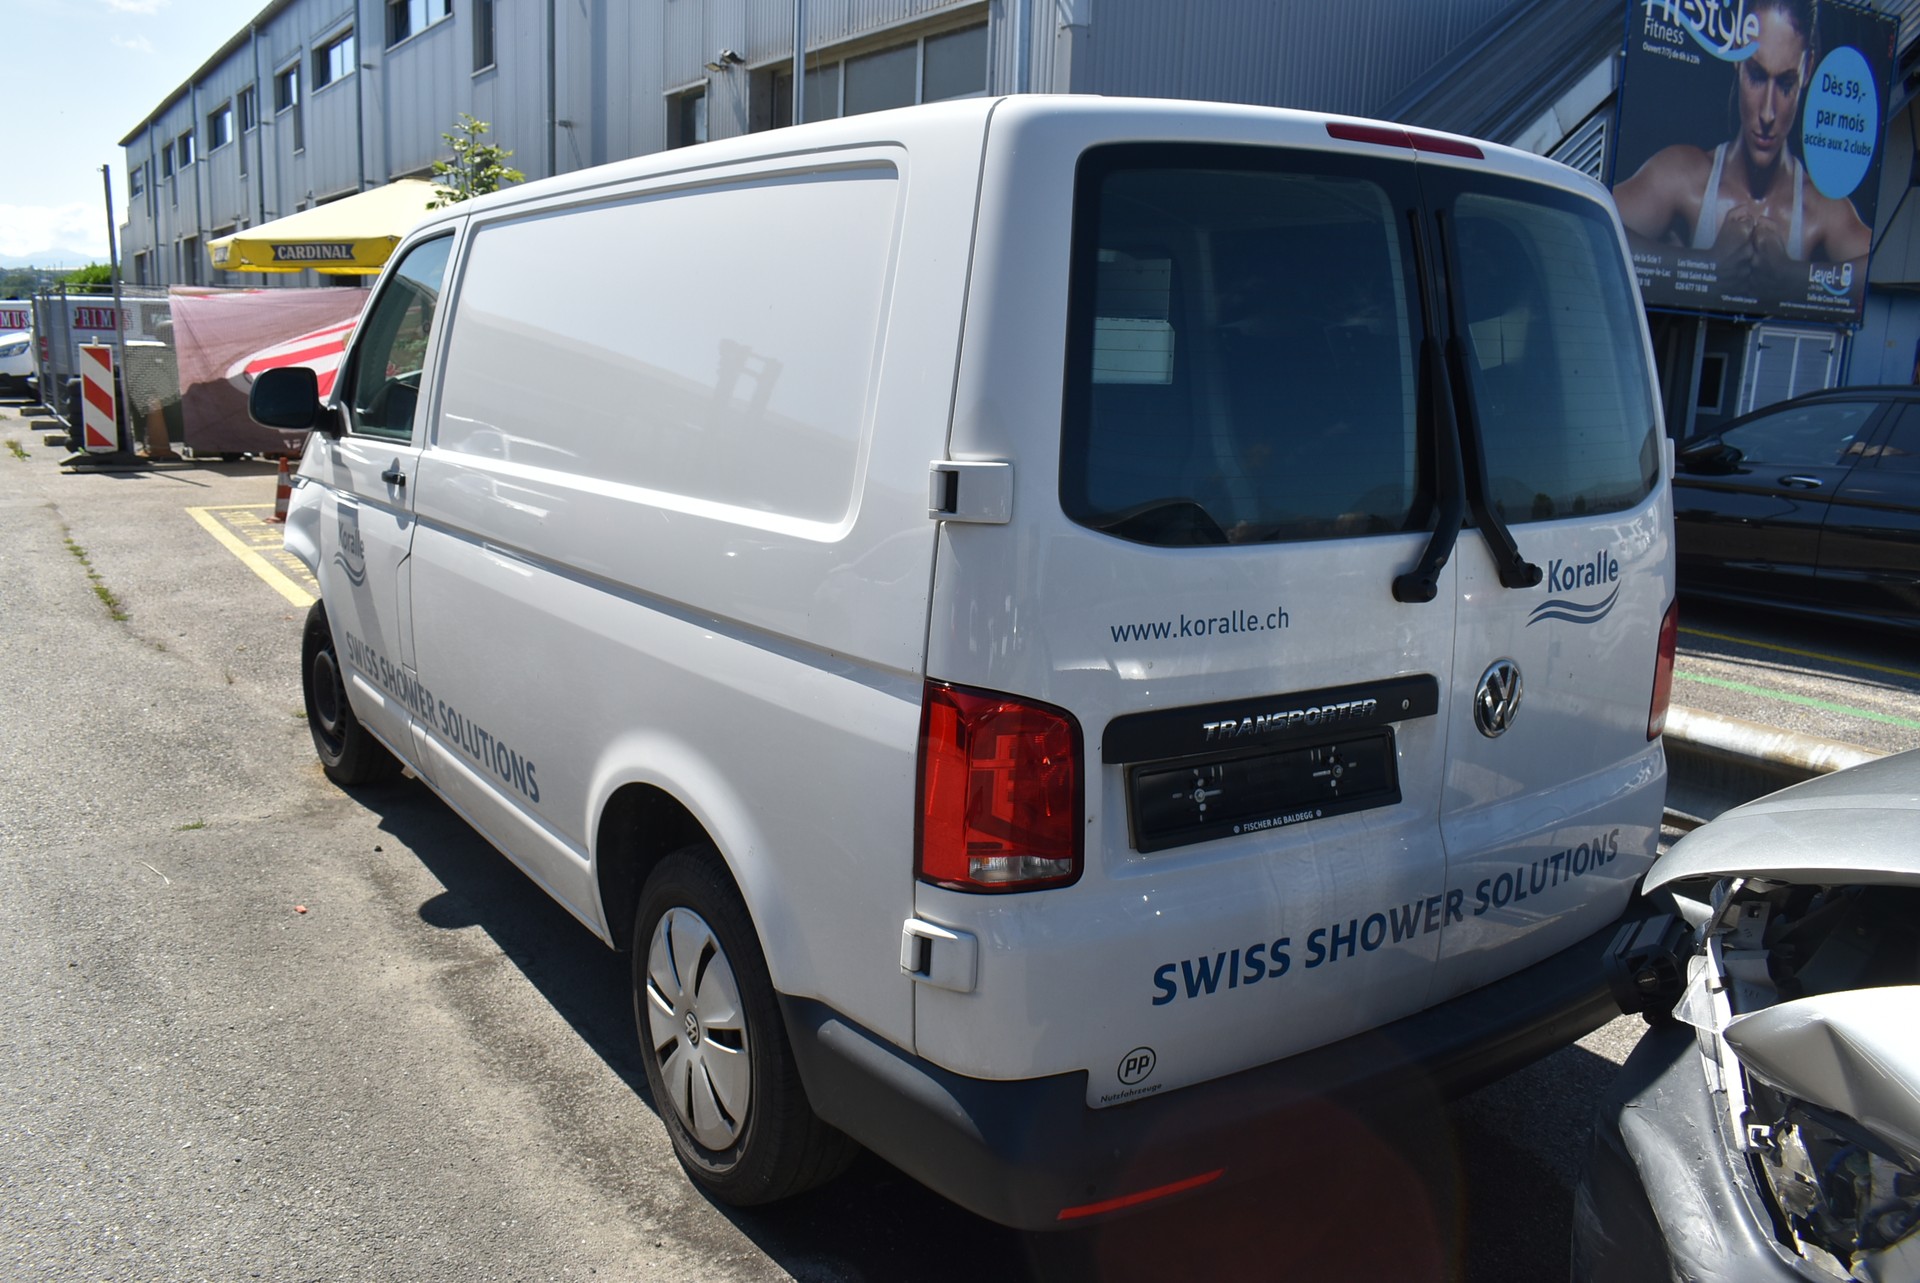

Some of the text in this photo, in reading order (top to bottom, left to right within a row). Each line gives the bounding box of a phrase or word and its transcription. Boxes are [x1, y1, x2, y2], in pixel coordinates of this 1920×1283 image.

[1644, 17, 1684, 45] Fitness
[1822, 73, 1843, 96] Dès
[1816, 110, 1865, 133] par mois
[1804, 133, 1871, 157] accès aux 2 clubs
[277, 245, 350, 260] CARDINAL
[1547, 550, 1620, 593] Koralle
[1110, 606, 1290, 643] www.koralle.ch
[346, 632, 540, 803] SWISS SHOWER SOLUTIONS
[1203, 699, 1377, 741] TRANSPORTER
[1243, 811, 1314, 832] FISCHER AG BALDEGG
[1152, 828, 1619, 1005] SWISS SHOWER SOLUTIONS
[1100, 1084, 1162, 1103] Nutzfahrzeuge
